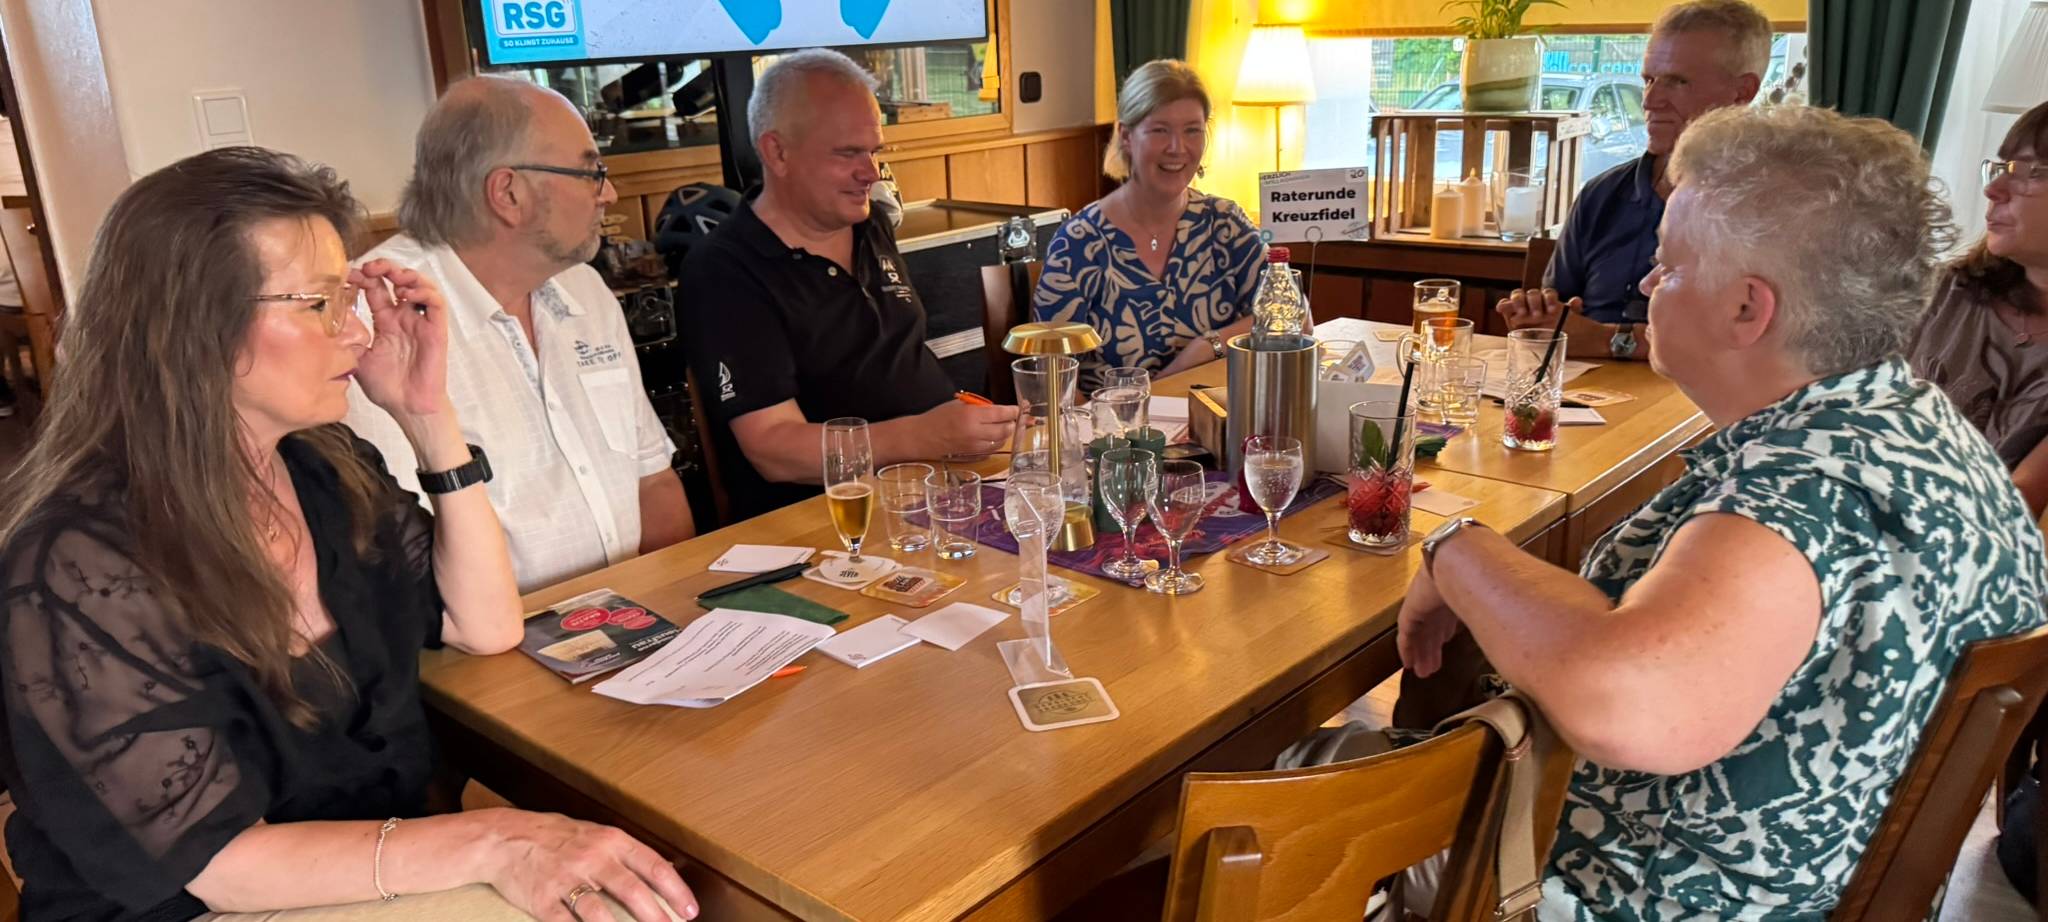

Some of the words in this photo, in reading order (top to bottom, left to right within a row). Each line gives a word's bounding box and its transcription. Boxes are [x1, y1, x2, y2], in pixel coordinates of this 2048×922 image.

[503, 1, 566, 30] RSG
[503, 40, 514, 48] SO
[515, 38, 540, 47] KLINGT
[541, 36, 574, 46] ZUHAUSE
[1271, 187, 1356, 203] Raterunde
[1272, 207, 1355, 223] Kreuzfidel
